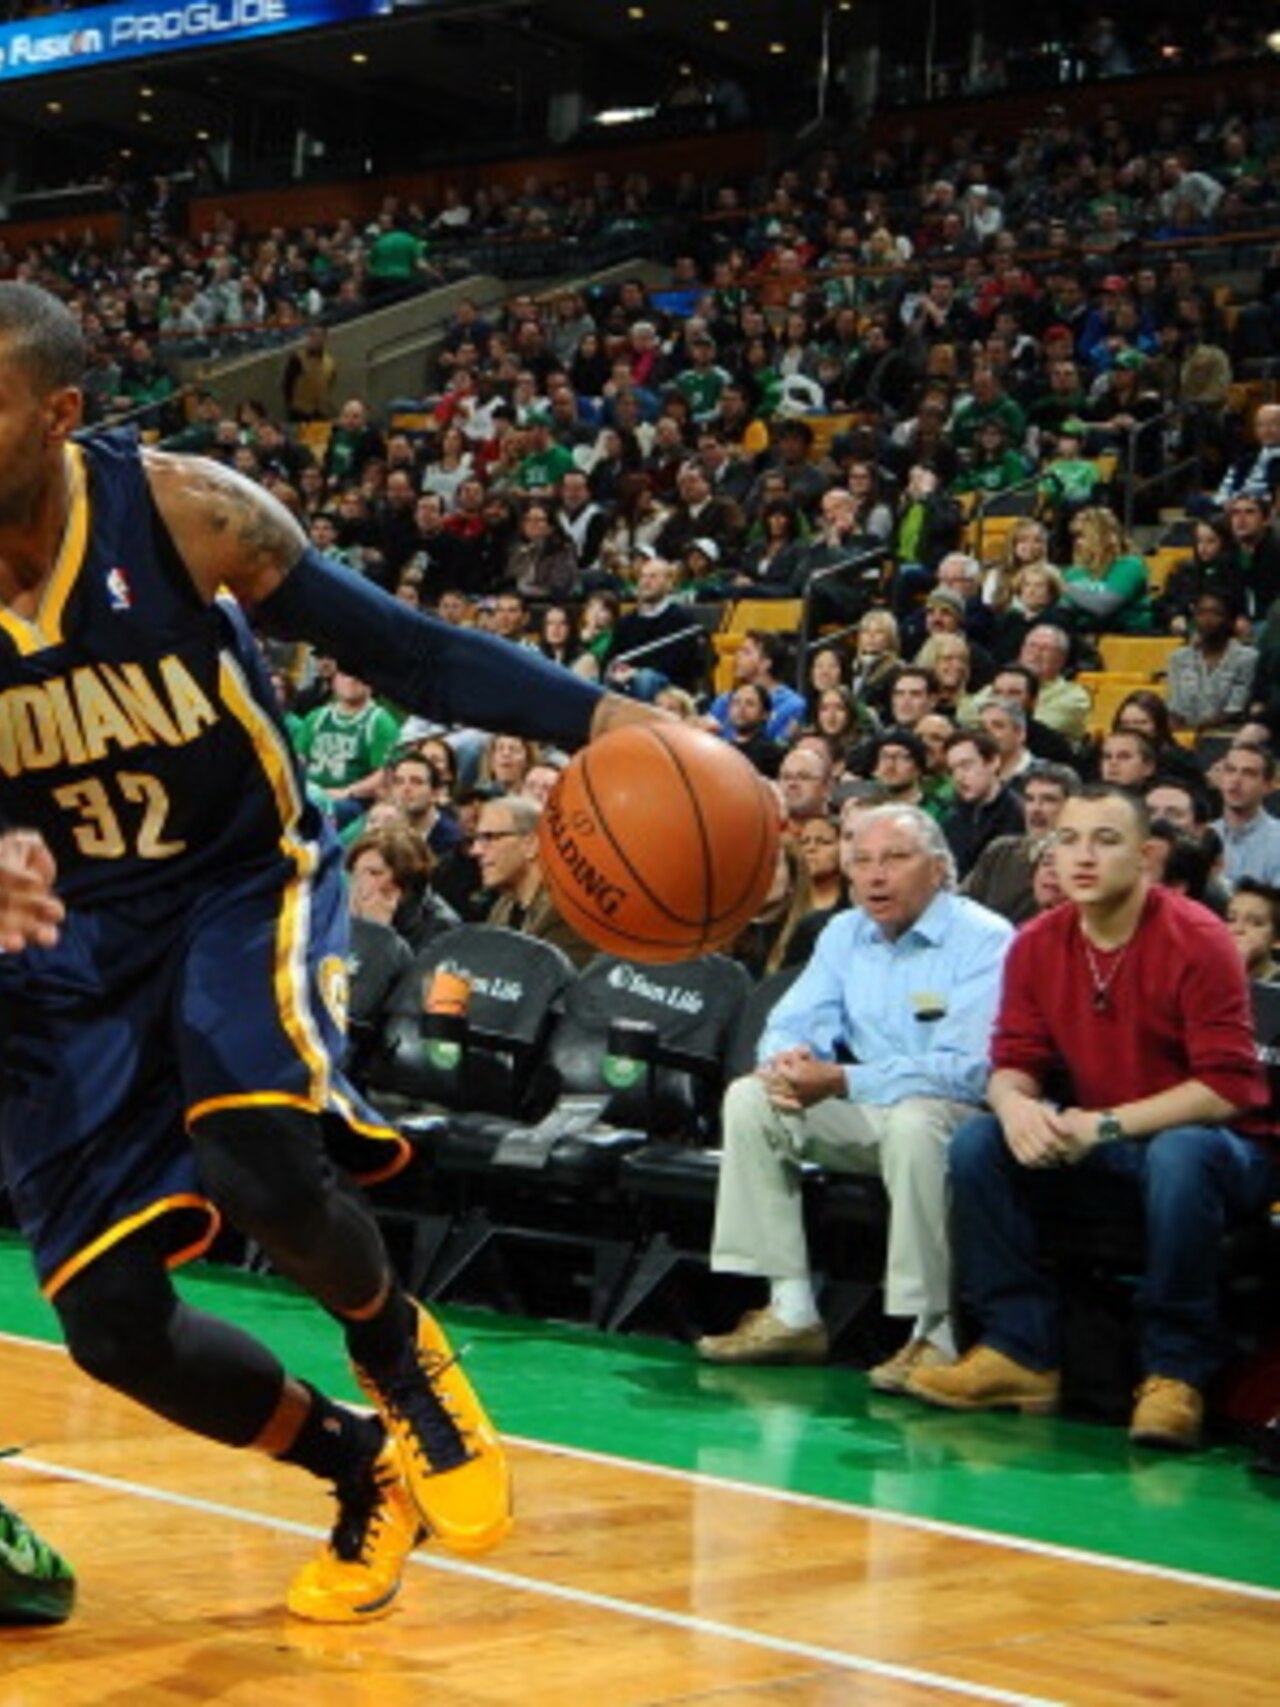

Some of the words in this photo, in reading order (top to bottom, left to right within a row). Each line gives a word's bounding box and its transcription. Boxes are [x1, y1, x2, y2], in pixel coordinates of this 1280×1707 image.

[9, 28, 103, 67] Fusion
[111, 0, 287, 47] PROGLIDE
[51, 769, 187, 859] 32
